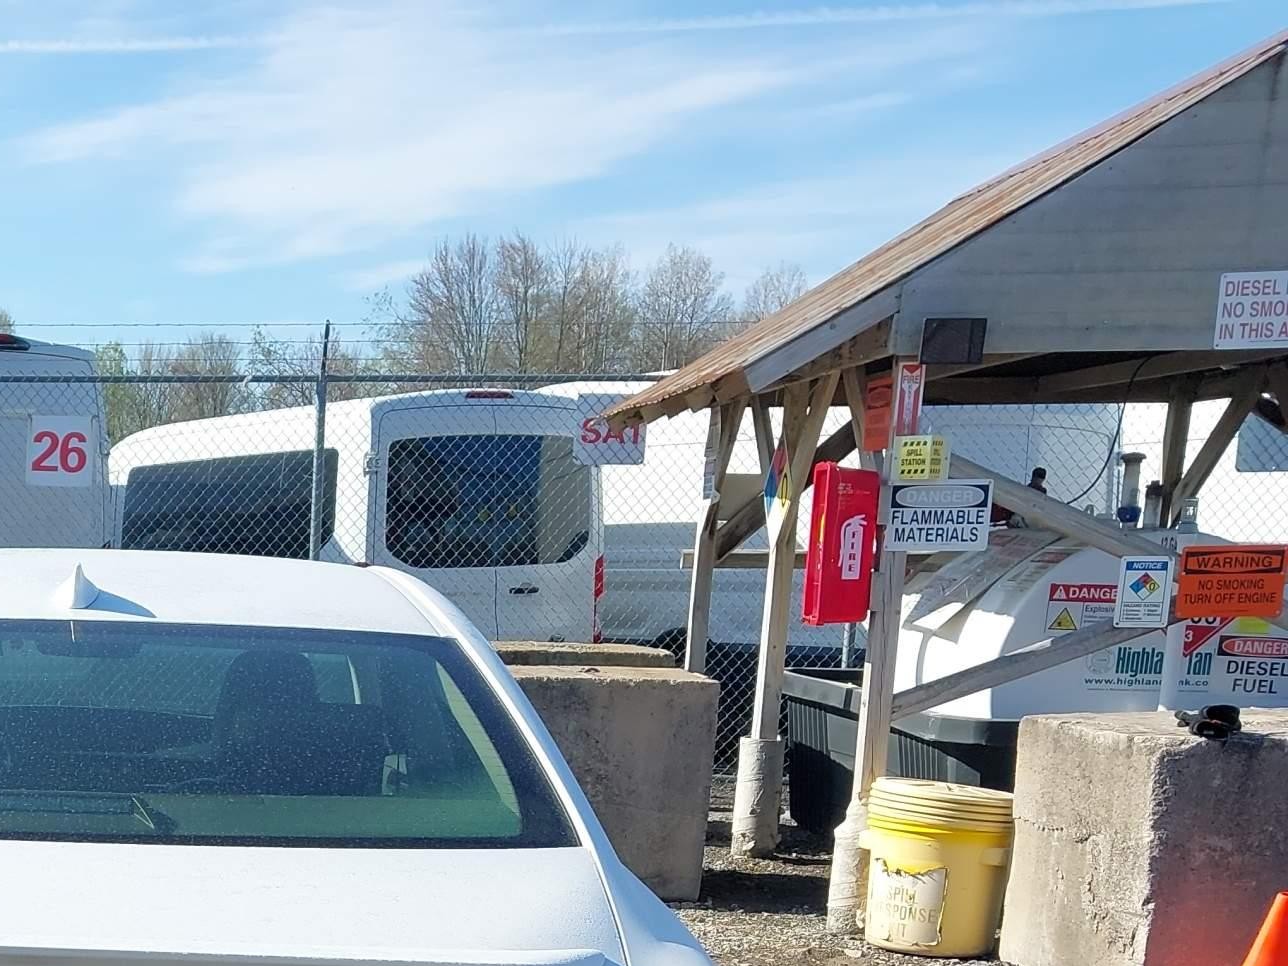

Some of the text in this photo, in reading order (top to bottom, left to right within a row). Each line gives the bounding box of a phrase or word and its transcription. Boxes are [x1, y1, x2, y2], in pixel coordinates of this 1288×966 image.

[1224, 279, 1281, 297] DIESEL
[1222, 300, 1288, 318] NO SMO
[1219, 323, 1235, 340] IN
[1239, 321, 1274, 339] THIS
[902, 375, 920, 385] FIRE
[31, 430, 88, 473] 26
[906, 448, 923, 457] SPILL
[900, 458, 927, 466] STATION
[906, 489, 974, 502] DANGER
[891, 509, 985, 526] FLAMMABLE
[893, 527, 979, 542] MATERIALS
[847, 529, 859, 573] FIRE
[1132, 562, 1163, 570] NOTICE
[1196, 555, 1273, 569] WARNING
[1198, 578, 1265, 590] NO SMOKING
[1068, 587, 1118, 600] DANGE
[1184, 592, 1277, 605] TURN OFF ENGINE
[1085, 604, 1115, 614] Explosiv
[1234, 640, 1288, 655] DANGER
[1115, 646, 1164, 678] Highla
[1226, 660, 1288, 677] DIESEL
[1232, 678, 1278, 695] FUEL
